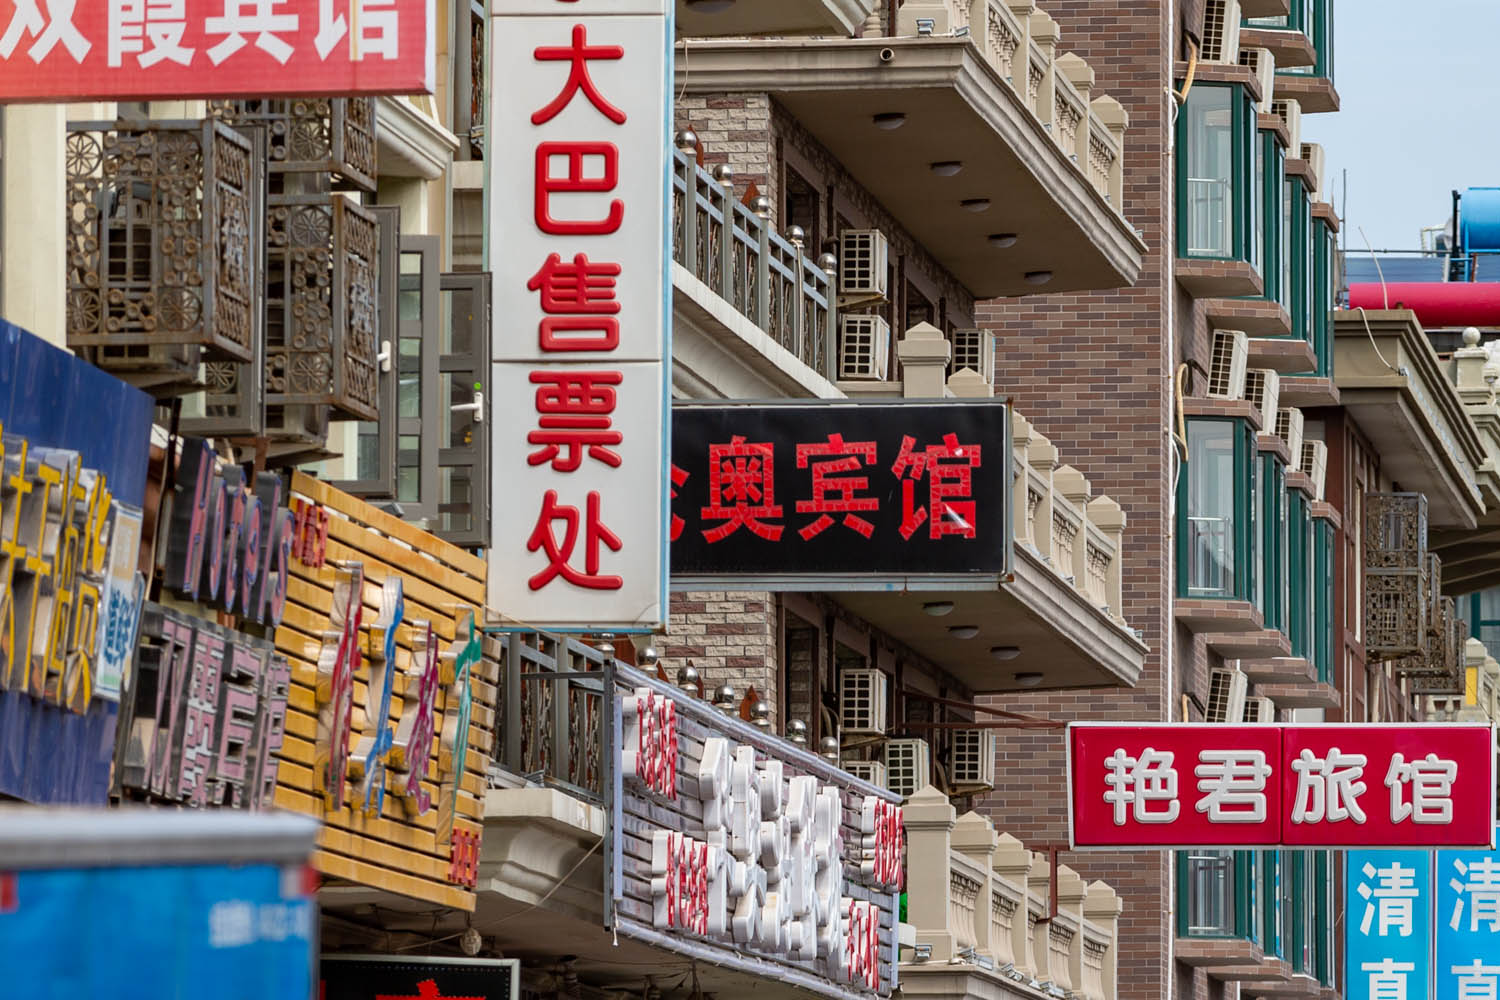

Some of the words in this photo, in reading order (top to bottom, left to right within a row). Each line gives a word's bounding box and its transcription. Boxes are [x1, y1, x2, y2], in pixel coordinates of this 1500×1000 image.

[527, 23, 627, 592] 大巴售票处
[1103, 746, 1459, 826] 艳君旅馆
